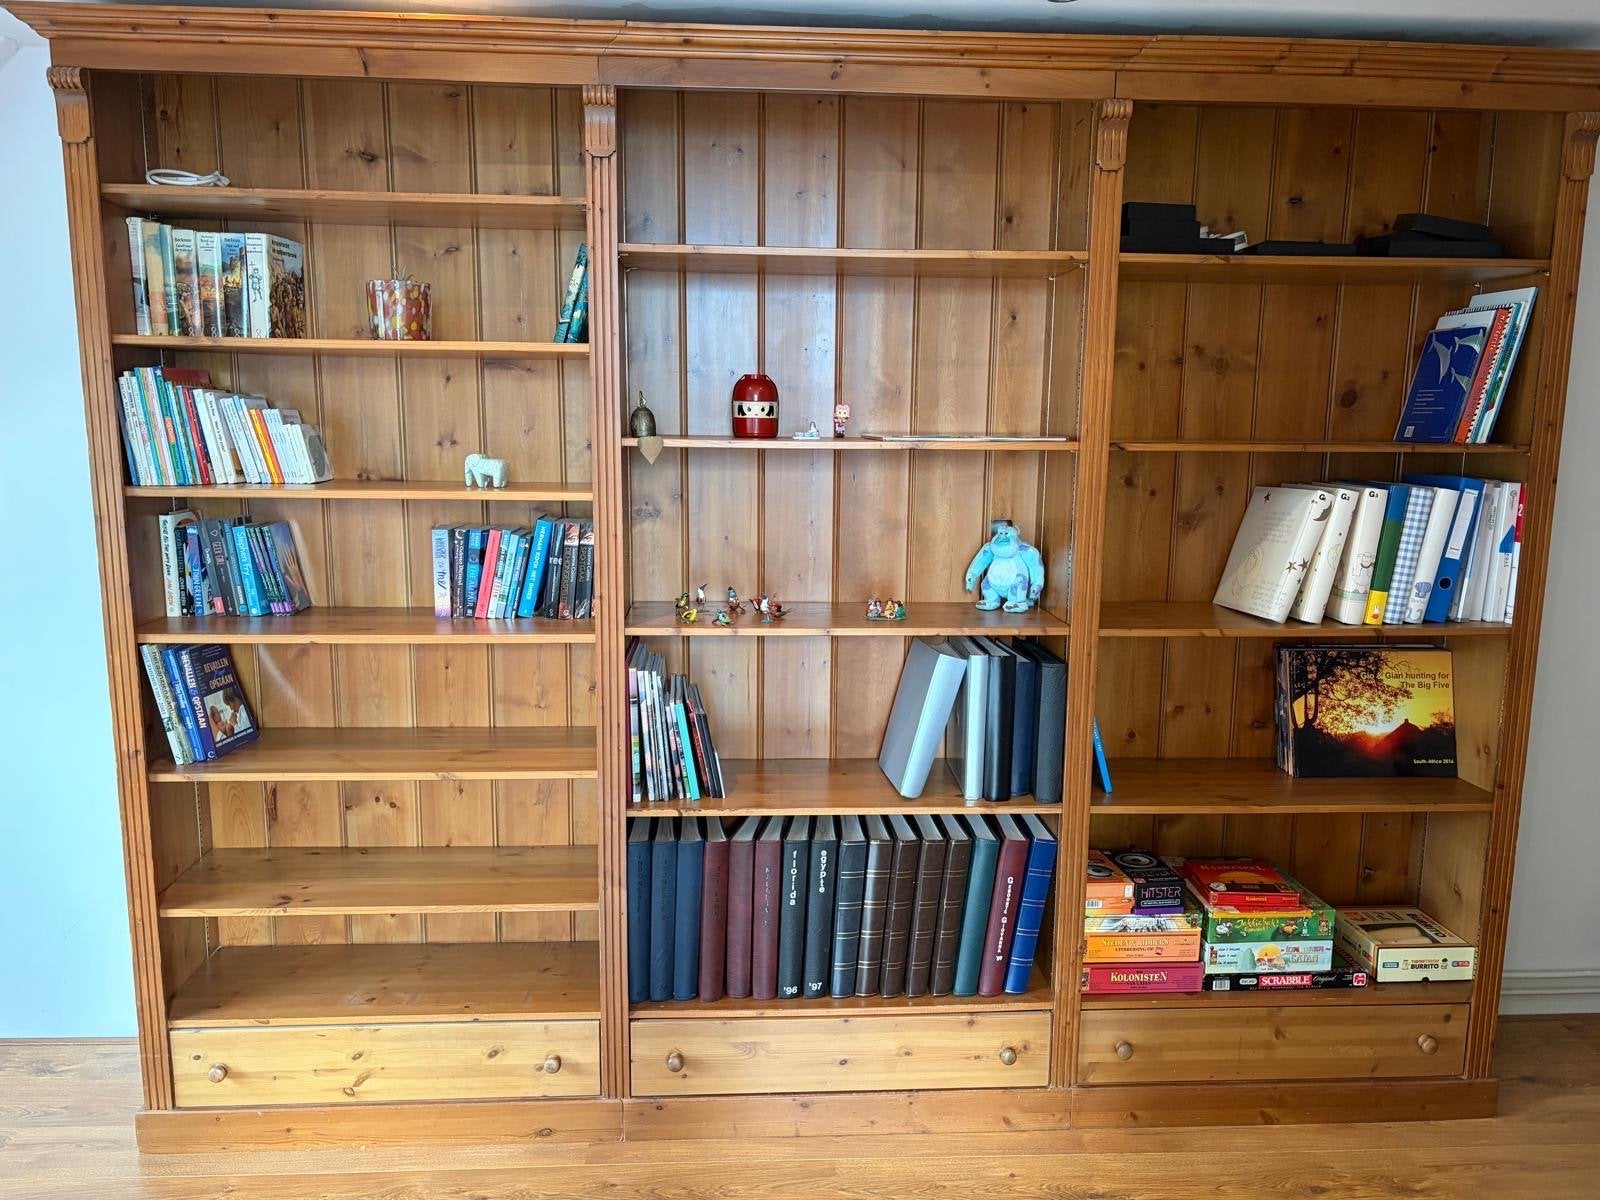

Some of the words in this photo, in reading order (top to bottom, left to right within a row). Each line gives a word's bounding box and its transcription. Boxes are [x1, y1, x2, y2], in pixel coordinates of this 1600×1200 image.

[1406, 672, 1436, 680] hunting
[181, 655, 196, 688] BEVALLEN
[192, 696, 207, 728] OPSTAAN
[1111, 971, 1168, 982] KOLONISTEN
[1261, 976, 1310, 985] SCRABBLE
[783, 986, 798, 994] '96
[808, 982, 822, 991] '97
